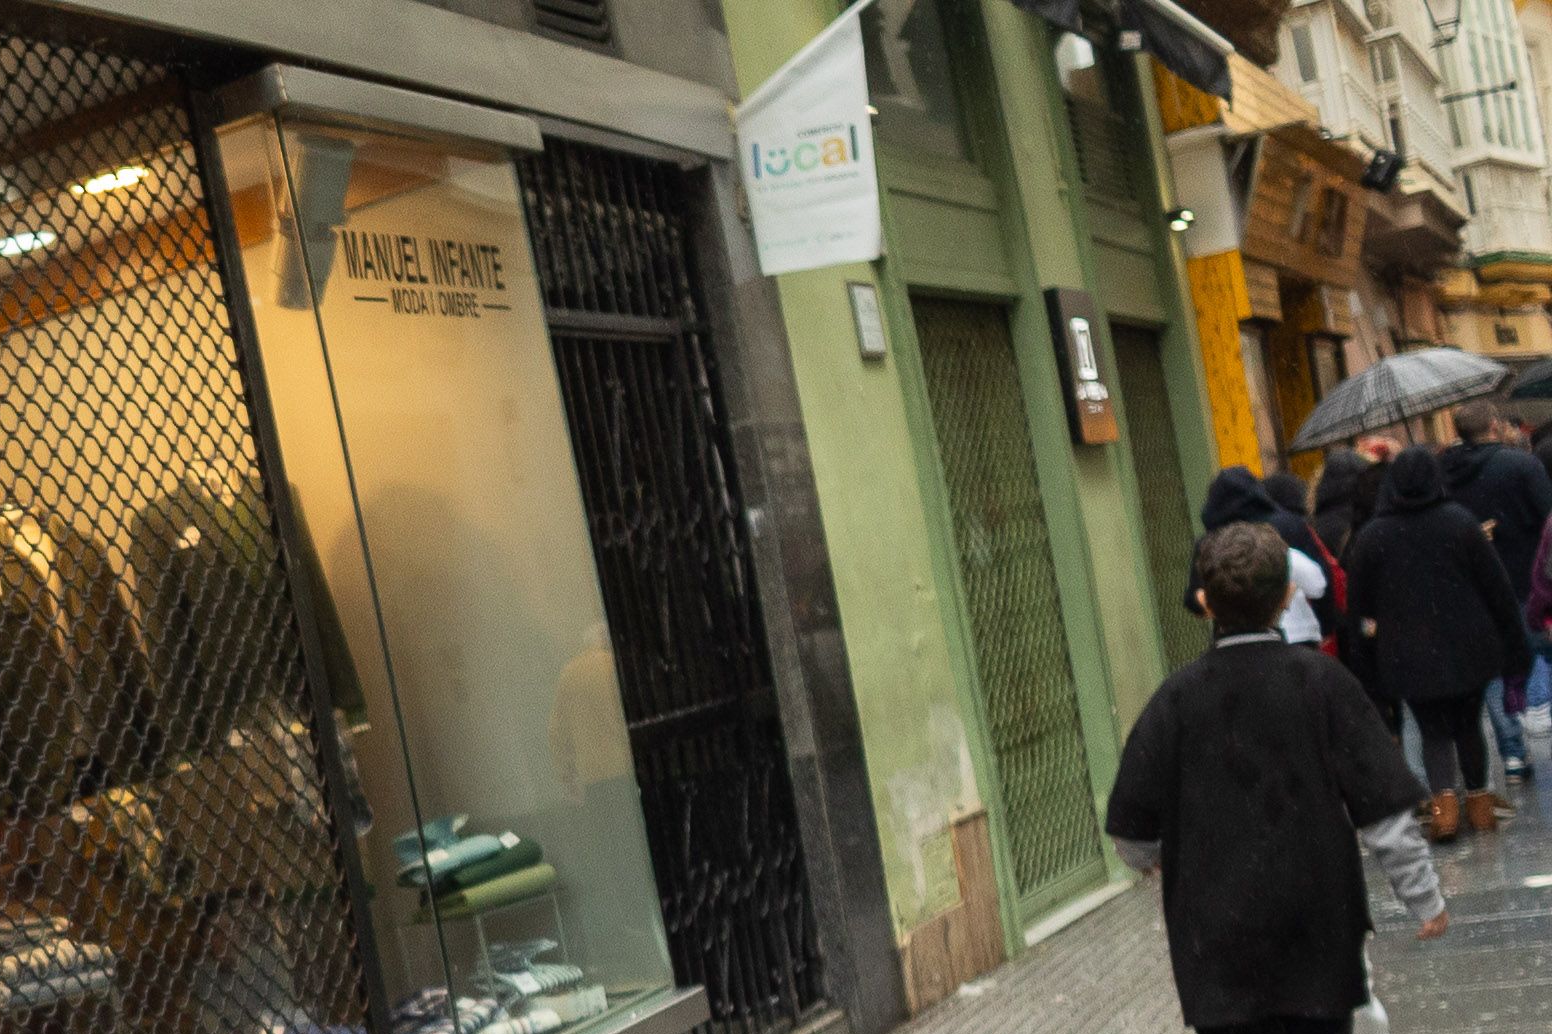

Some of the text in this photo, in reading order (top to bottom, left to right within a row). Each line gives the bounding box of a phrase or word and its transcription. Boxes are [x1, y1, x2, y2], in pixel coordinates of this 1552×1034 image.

[342, 230, 506, 290] MANUEL INFANTE
[392, 287, 431, 316] MODA
